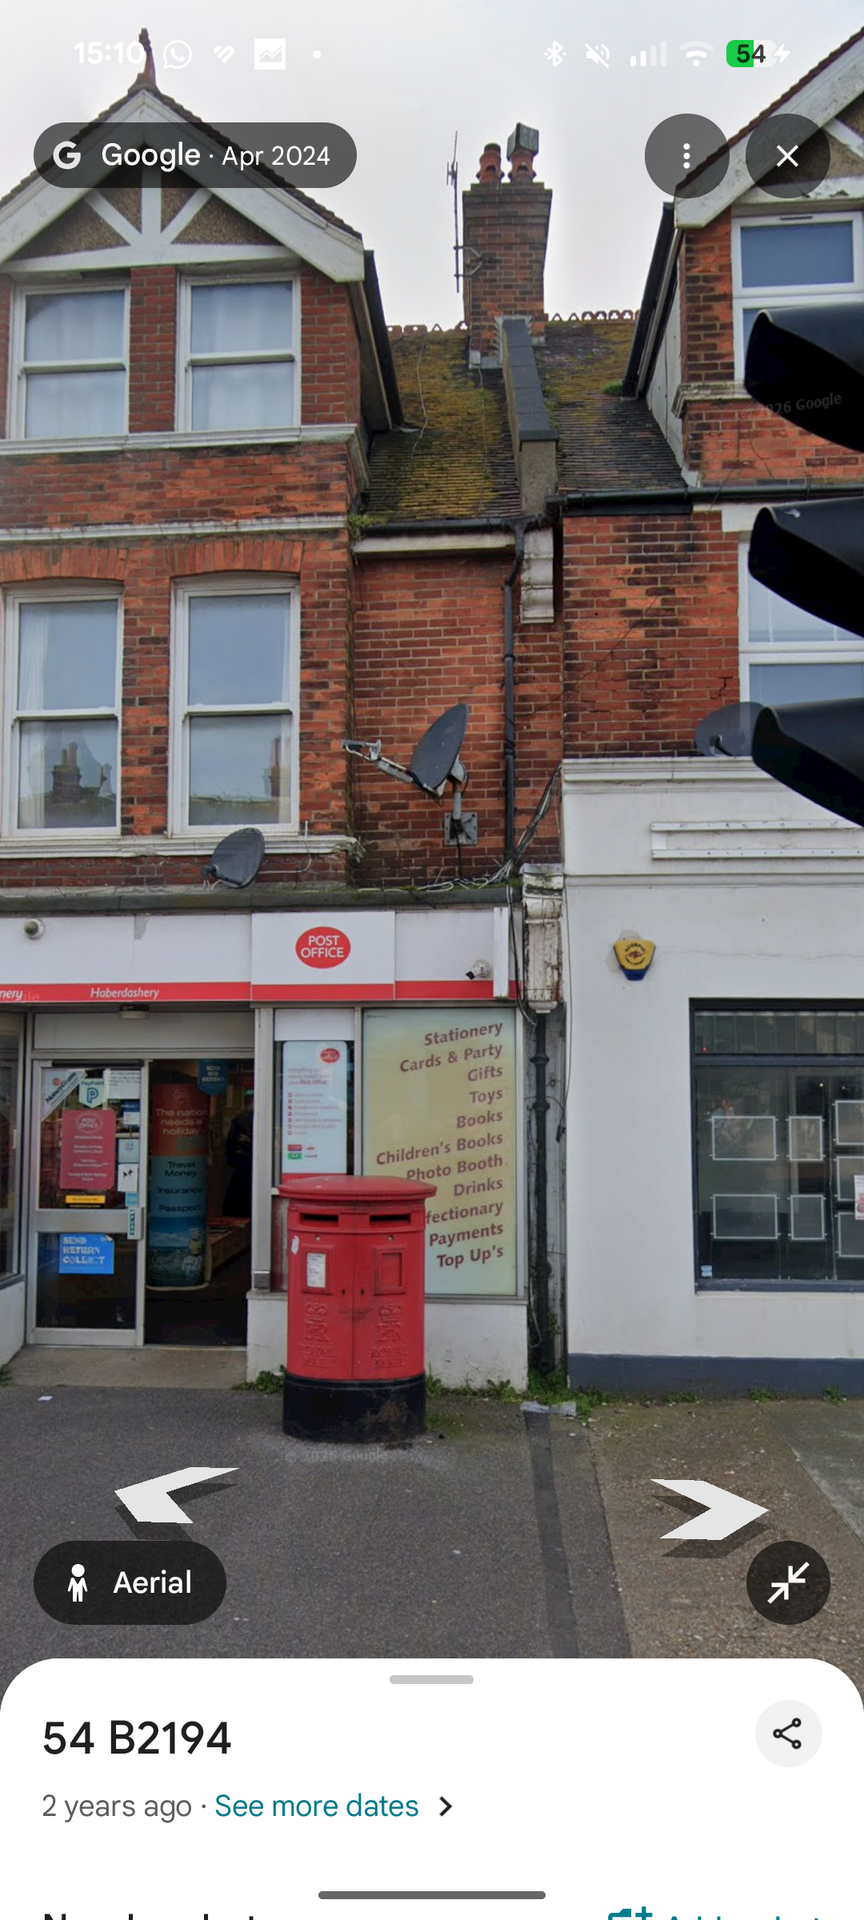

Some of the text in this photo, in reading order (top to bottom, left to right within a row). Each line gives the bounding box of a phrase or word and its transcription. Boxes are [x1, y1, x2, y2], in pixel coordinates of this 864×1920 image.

[308, 935, 341, 946] POST
[300, 947, 345, 958] OFFICE
[0, 990, 23, 1001] nery
[90, 987, 160, 1000] Haberdashery
[424, 1023, 503, 1046] Stationery
[399, 1044, 503, 1073] Cards & Party
[467, 1066, 503, 1082] Gifts
[45, 1071, 77, 1104] MoneyGram
[469, 1089, 503, 1104] Toys
[156, 1108, 208, 1117] The nation
[161, 1118, 194, 1126] needs
[456, 1110, 503, 1129] Books
[163, 1127, 200, 1138] holiday
[376, 1132, 503, 1165] Children's Books
[166, 1160, 196, 1169] Travel
[406, 1154, 503, 1181] Photo Booth
[164, 1169, 197, 1179] Money
[156, 1186, 204, 1195] Insurance
[454, 1177, 503, 1197] Drinks
[158, 1203, 202, 1213] Passport
[425, 1201, 504, 1225] fectionary
[63, 1237, 88, 1245] SEND
[429, 1223, 504, 1247] Payments
[63, 1246, 101, 1255] RETURN
[63, 1255, 106, 1265] COLLECT
[436, 1245, 504, 1269] Top Up's
